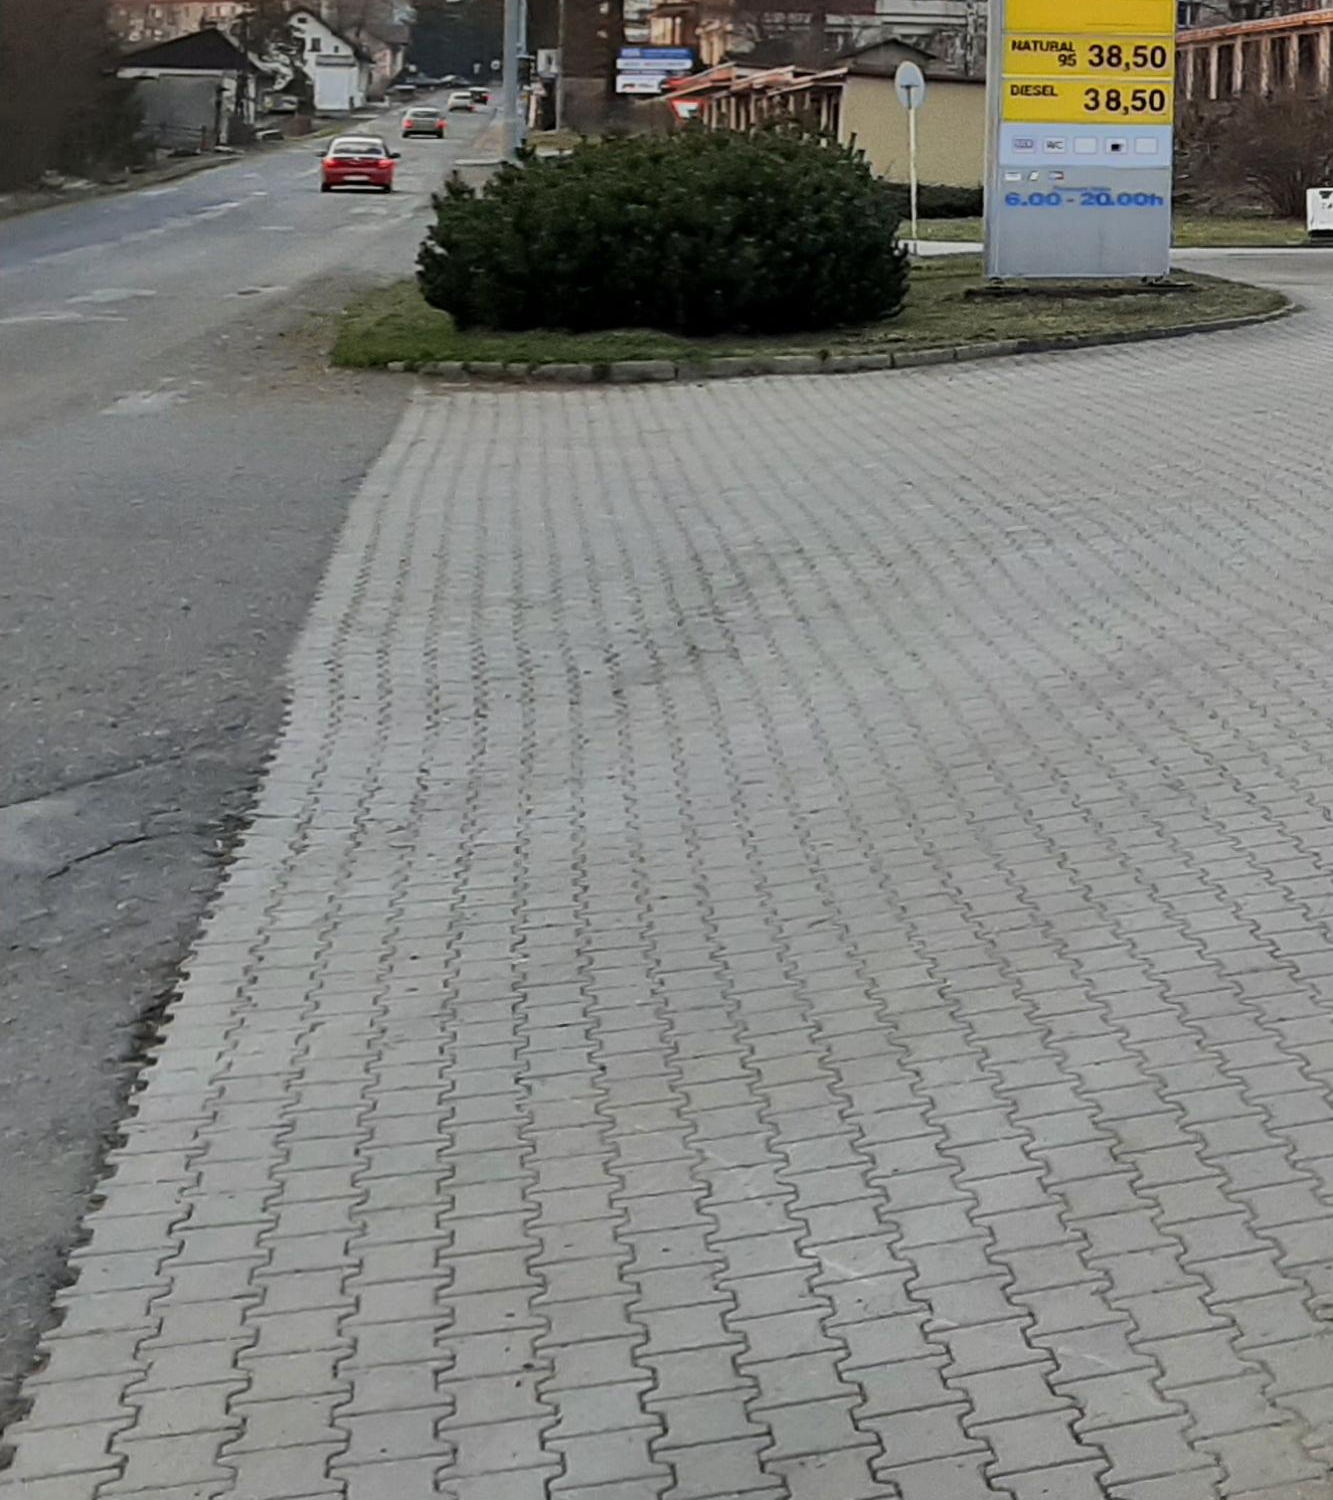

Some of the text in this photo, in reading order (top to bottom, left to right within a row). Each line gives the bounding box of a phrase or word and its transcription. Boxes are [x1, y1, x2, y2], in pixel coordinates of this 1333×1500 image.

[1011, 40, 1167, 71] NATURAL 38,50
[1057, 53, 1077, 67] 95
[1010, 85, 1166, 115] DIESEL 38,50
[1005, 191, 1062, 207] 6.00
